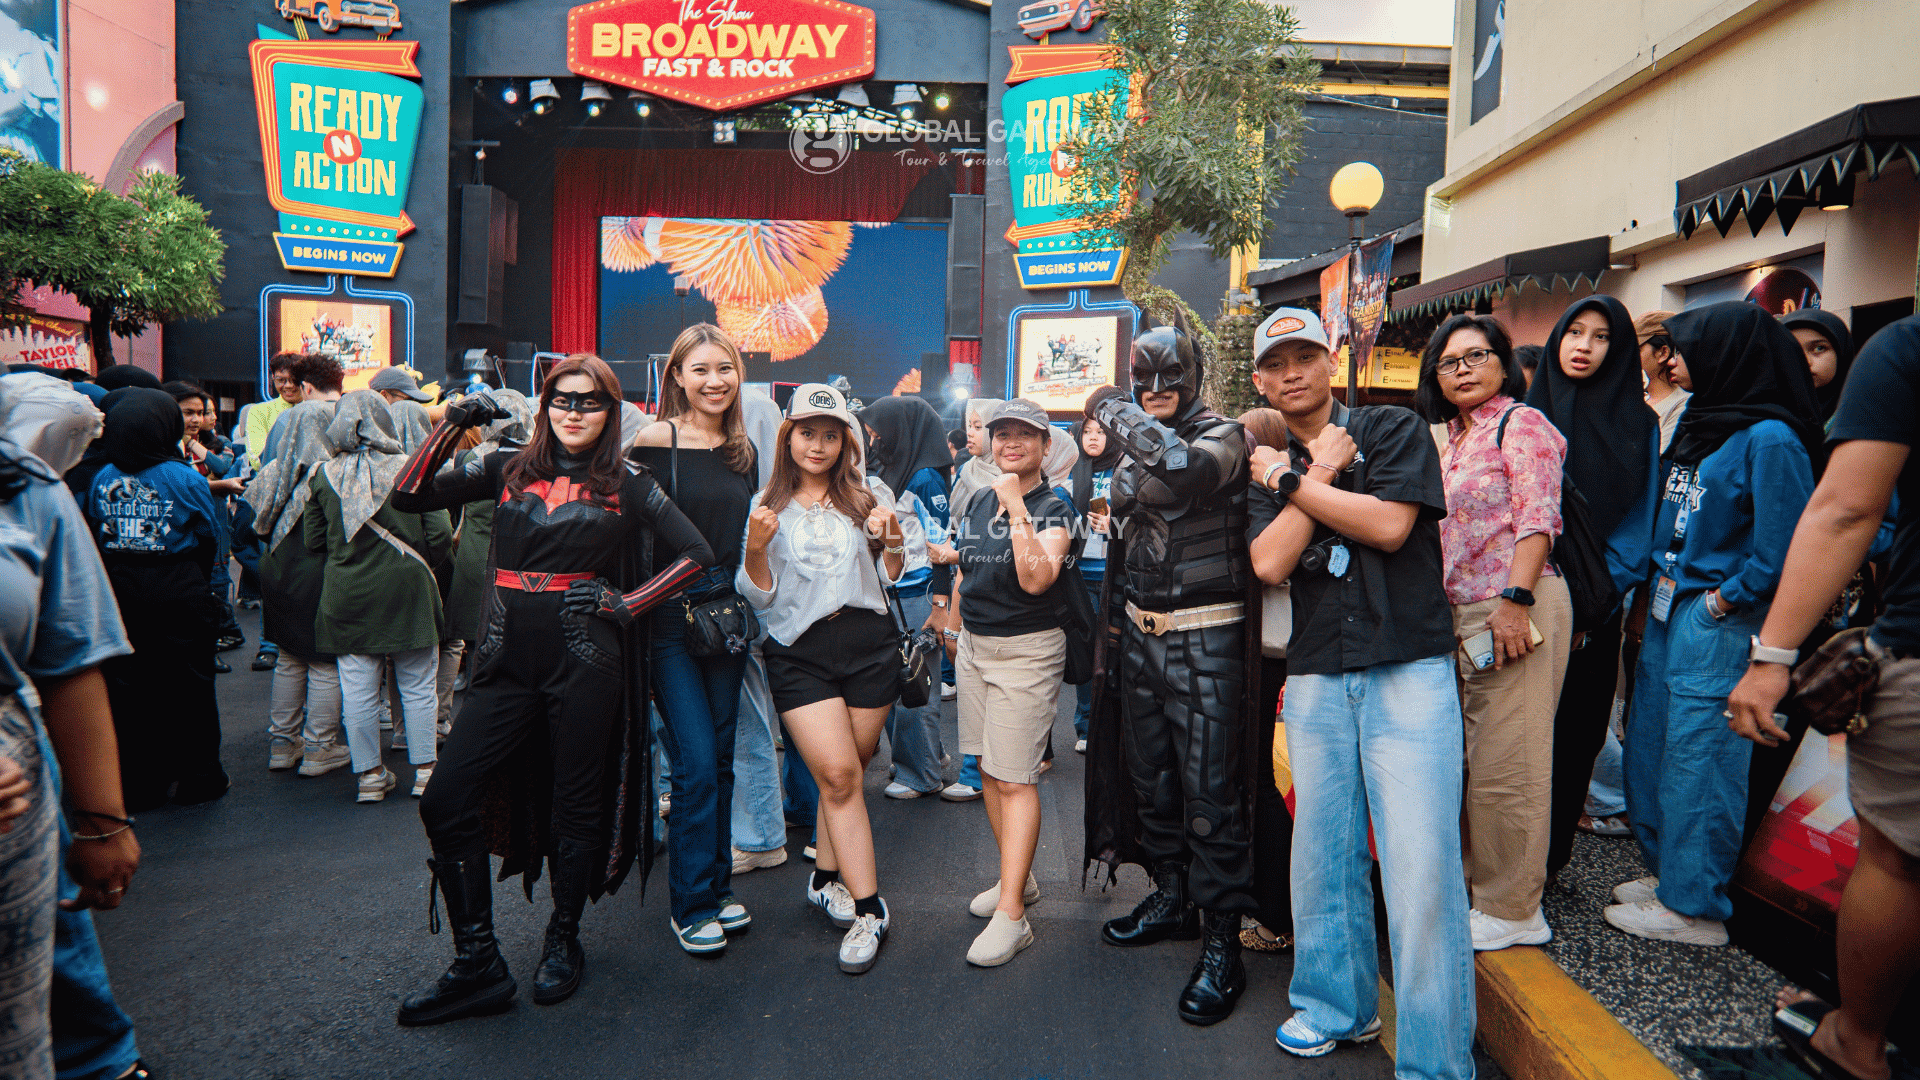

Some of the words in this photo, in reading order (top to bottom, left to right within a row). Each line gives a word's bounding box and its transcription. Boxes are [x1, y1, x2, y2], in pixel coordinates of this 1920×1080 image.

[674, 0, 704, 26] The
[705, 0, 755, 30] Show
[592, 22, 849, 58] BROADWAY
[642, 58, 702, 77] FAST
[707, 58, 725, 77] &
[730, 59, 795, 77] ROCK
[289, 82, 403, 142] READY
[330, 134, 355, 158] N
[293, 150, 396, 197] ACTION
[292, 246, 348, 262] BEGINS
[351, 250, 387, 265] NOW
[1028, 262, 1076, 276] BEGINS
[1078, 260, 1111, 273] NOW
[19, 344, 77, 362] TAYLOR
